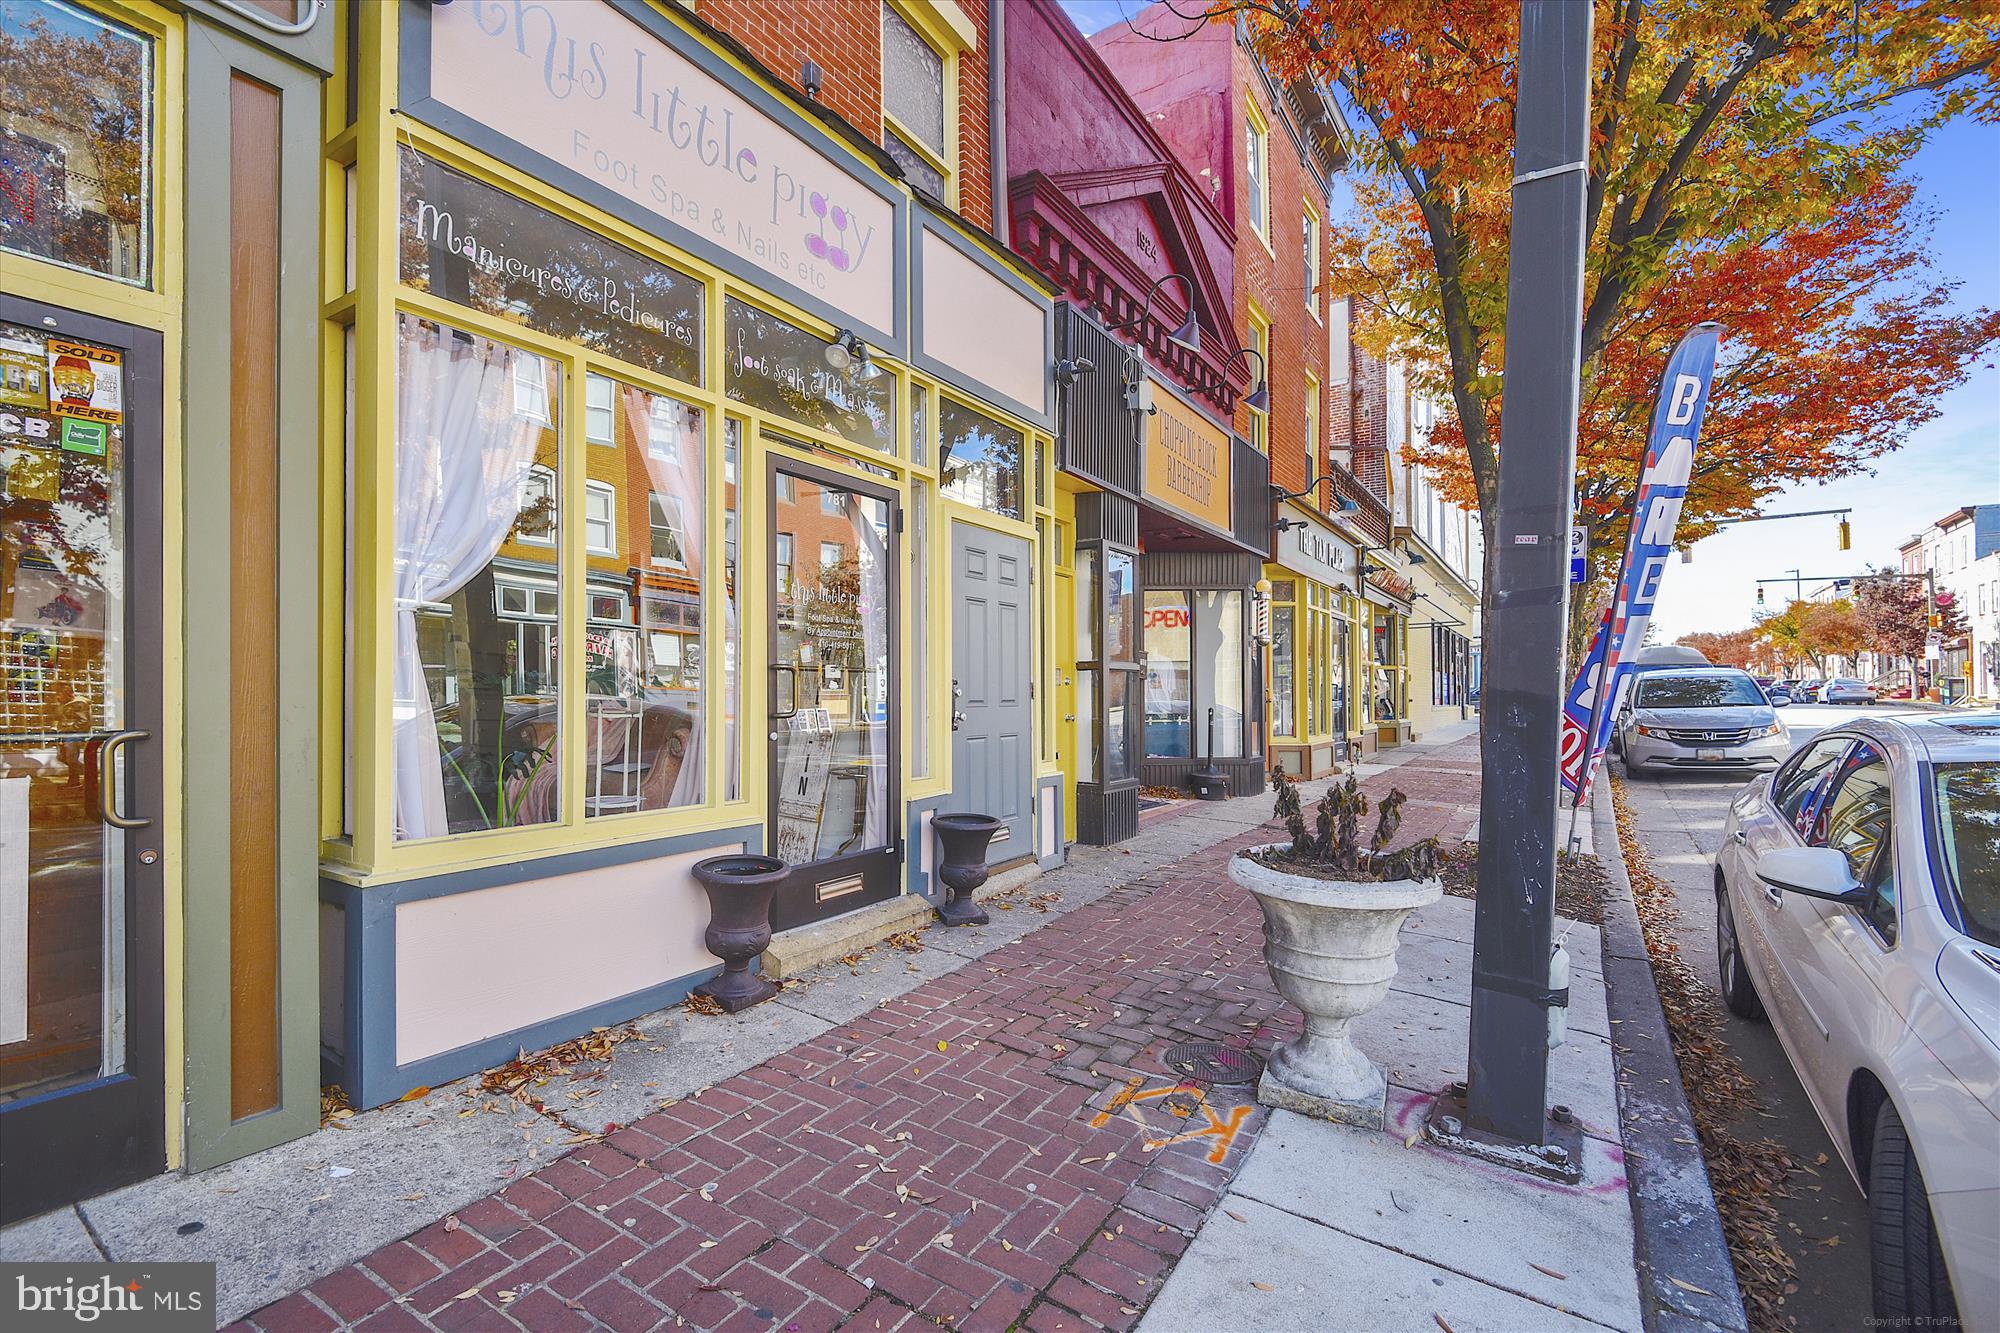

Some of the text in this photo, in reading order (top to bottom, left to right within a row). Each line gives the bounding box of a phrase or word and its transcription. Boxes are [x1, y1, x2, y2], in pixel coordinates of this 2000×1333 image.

[632, 48, 758, 184] little
[770, 164, 876, 273] piggy
[572, 129, 826, 290] Foot Spa & Nails etc
[416, 200, 694, 346] Manicures & Pedicures
[54, 344, 116, 364] SOLD
[734, 327, 769, 378] foot
[773, 363, 810, 401] soak
[55, 403, 120, 422] HERE
[1299, 528, 1313, 557] THE
[1315, 535, 1327, 564] TAX
[818, 582, 847, 604] little
[1143, 609, 1188, 628] OPEN
